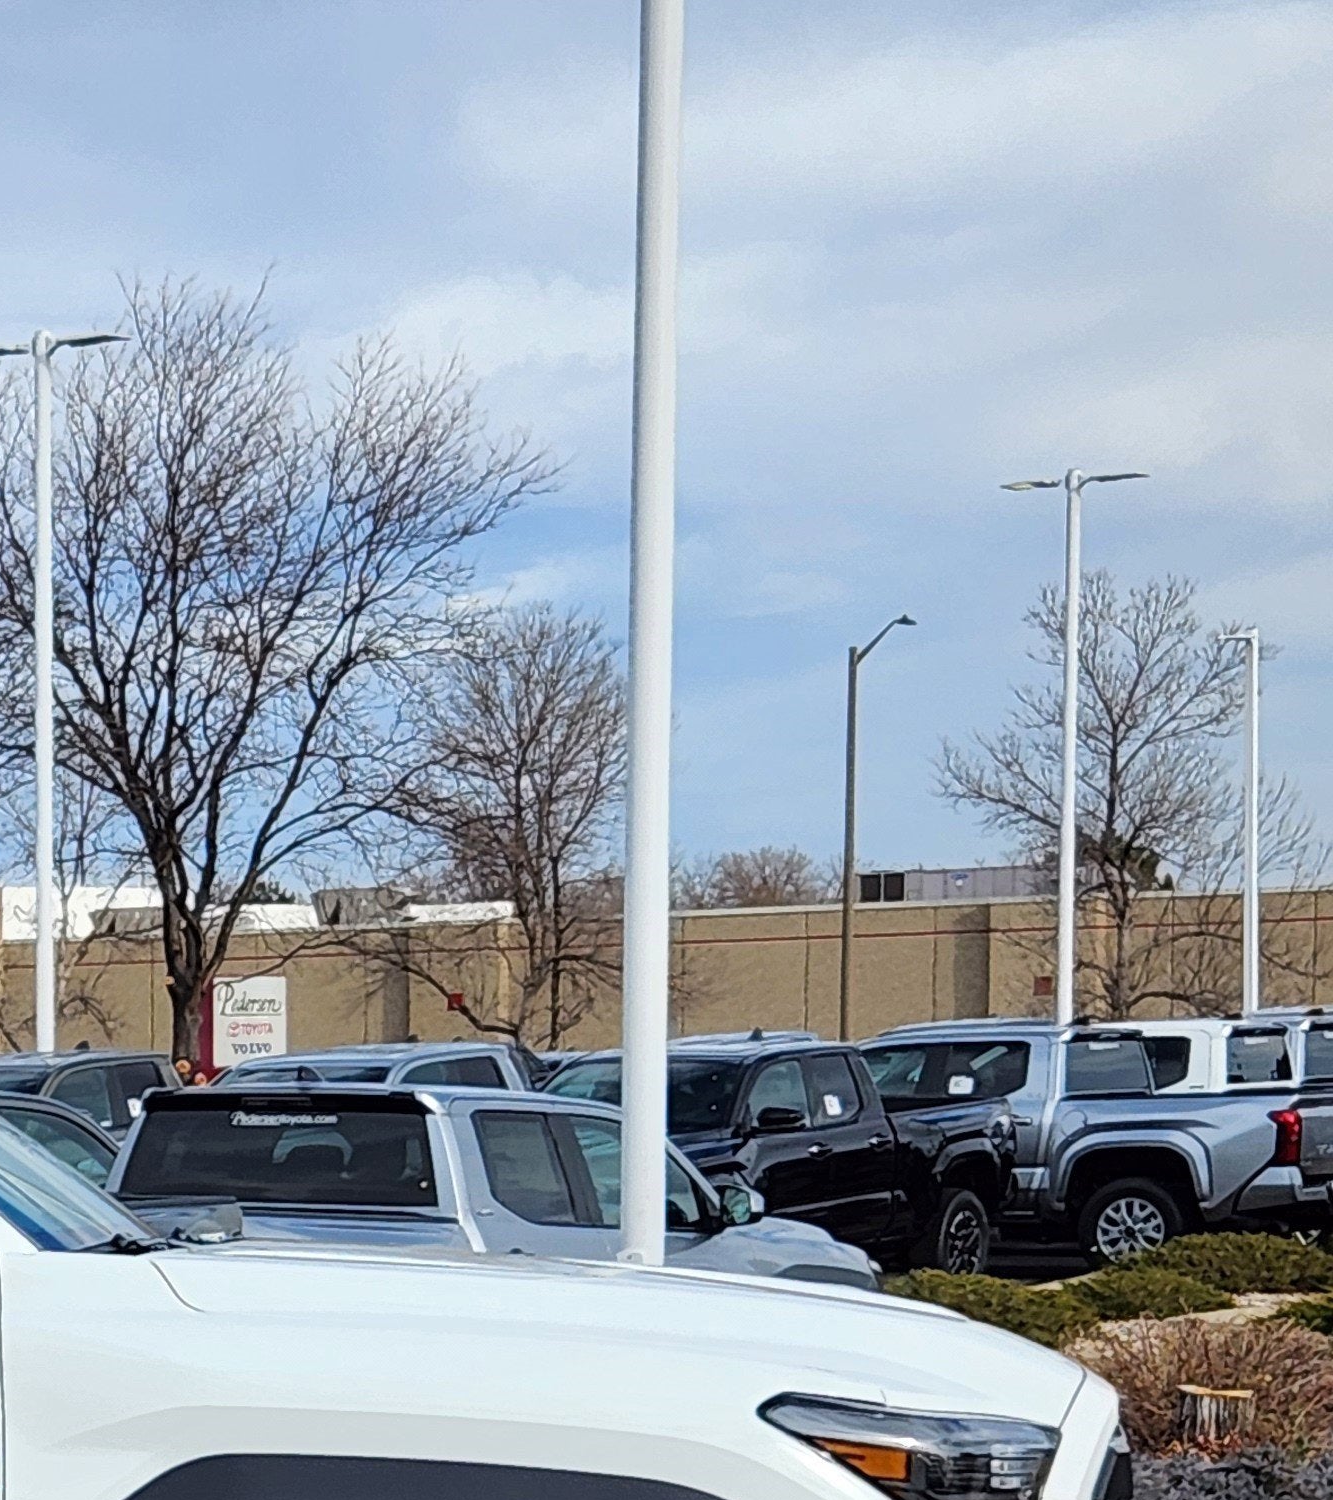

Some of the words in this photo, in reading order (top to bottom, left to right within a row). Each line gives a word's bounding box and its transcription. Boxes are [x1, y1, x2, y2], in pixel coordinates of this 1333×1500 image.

[218, 982, 282, 1016] Pedersen
[241, 1023, 274, 1035] TOYOTA
[231, 1043, 273, 1054] VOLVO
